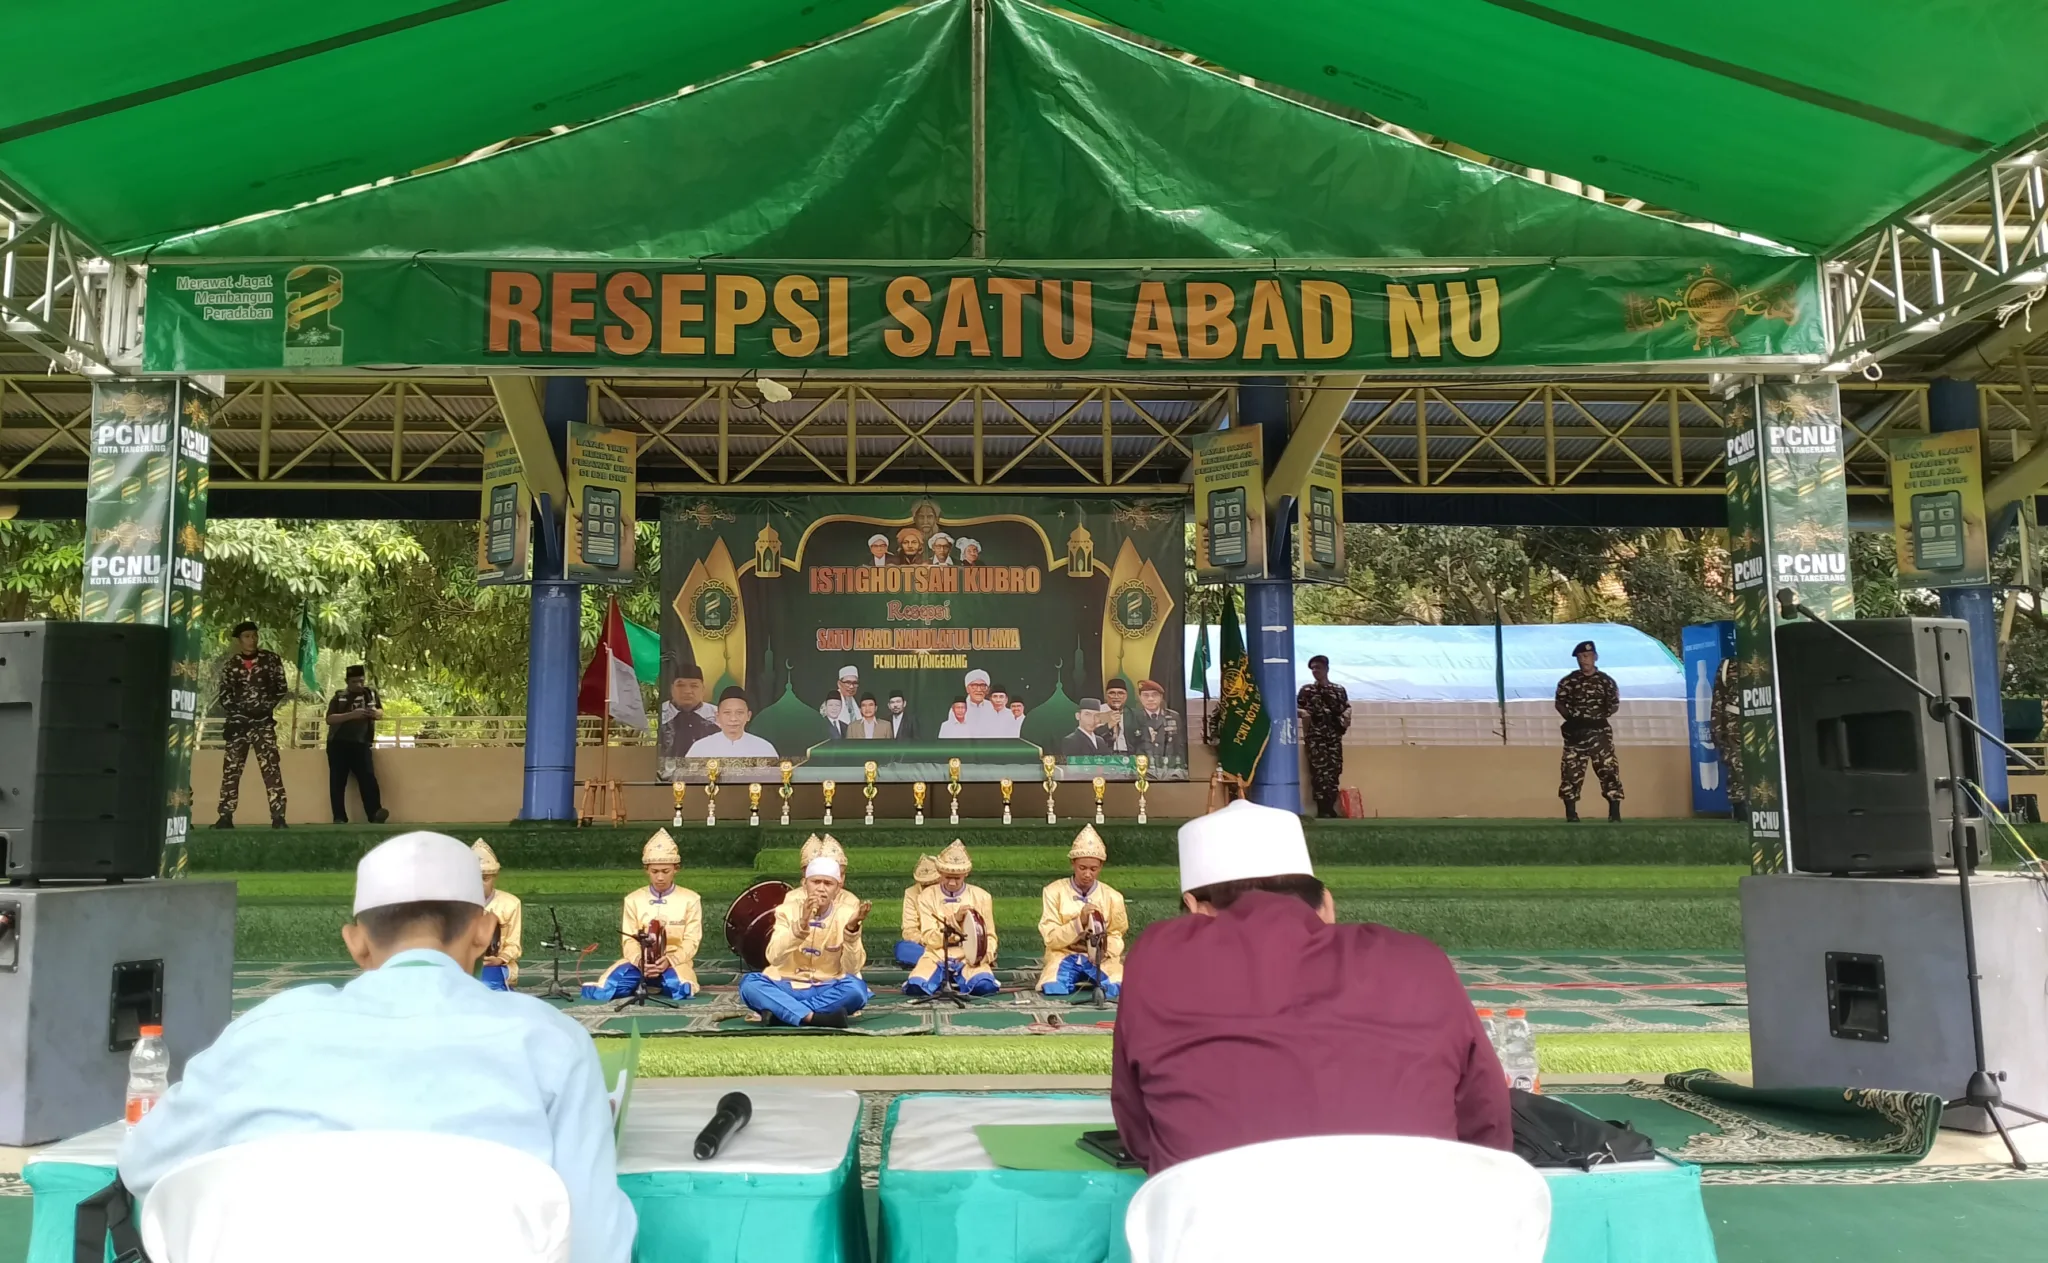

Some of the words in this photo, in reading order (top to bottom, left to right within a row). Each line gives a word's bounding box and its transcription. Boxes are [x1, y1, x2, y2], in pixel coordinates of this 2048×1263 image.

[176, 276, 234, 291] Merawat
[235, 274, 273, 291] Jagat
[194, 291, 273, 306] Membangun
[203, 306, 273, 321] Peradaban
[488, 271, 849, 358] RESEPSI
[883, 275, 1094, 360] SATU
[1126, 279, 1353, 360] ABAD
[1386, 278, 1500, 359] NU
[98, 424, 168, 446] PCNU
[1727, 429, 1755, 459] PCNU
[1769, 425, 1837, 446] PCNU
[97, 445, 118, 454] KOTA
[1771, 446, 1791, 454] KOTA
[1792, 445, 1837, 454] TANGERANG
[90, 555, 161, 577] PCNU
[1734, 556, 1763, 582] PCNU
[1777, 553, 1846, 575] PCNU
[90, 576, 111, 586] KOTA
[809, 565, 959, 594] ISTIGHOTSAH
[962, 565, 1042, 594] KUBRO
[1779, 574, 1798, 583] KOTA
[887, 600, 951, 625] Resepsi
[816, 627, 853, 651] SATU
[854, 627, 893, 651] ABAD
[893, 627, 971, 651] NAHDLATUL
[972, 627, 1021, 651] ULAMA
[873, 654, 896, 669] PCNU
[897, 654, 919, 669] KOTA
[919, 654, 968, 669] TANGERANG
[1743, 685, 1772, 708] PCNU
[1233, 723, 1251, 746] PCNU
[1244, 702, 1261, 724] KOTA
[1752, 811, 1780, 830] PCNU
